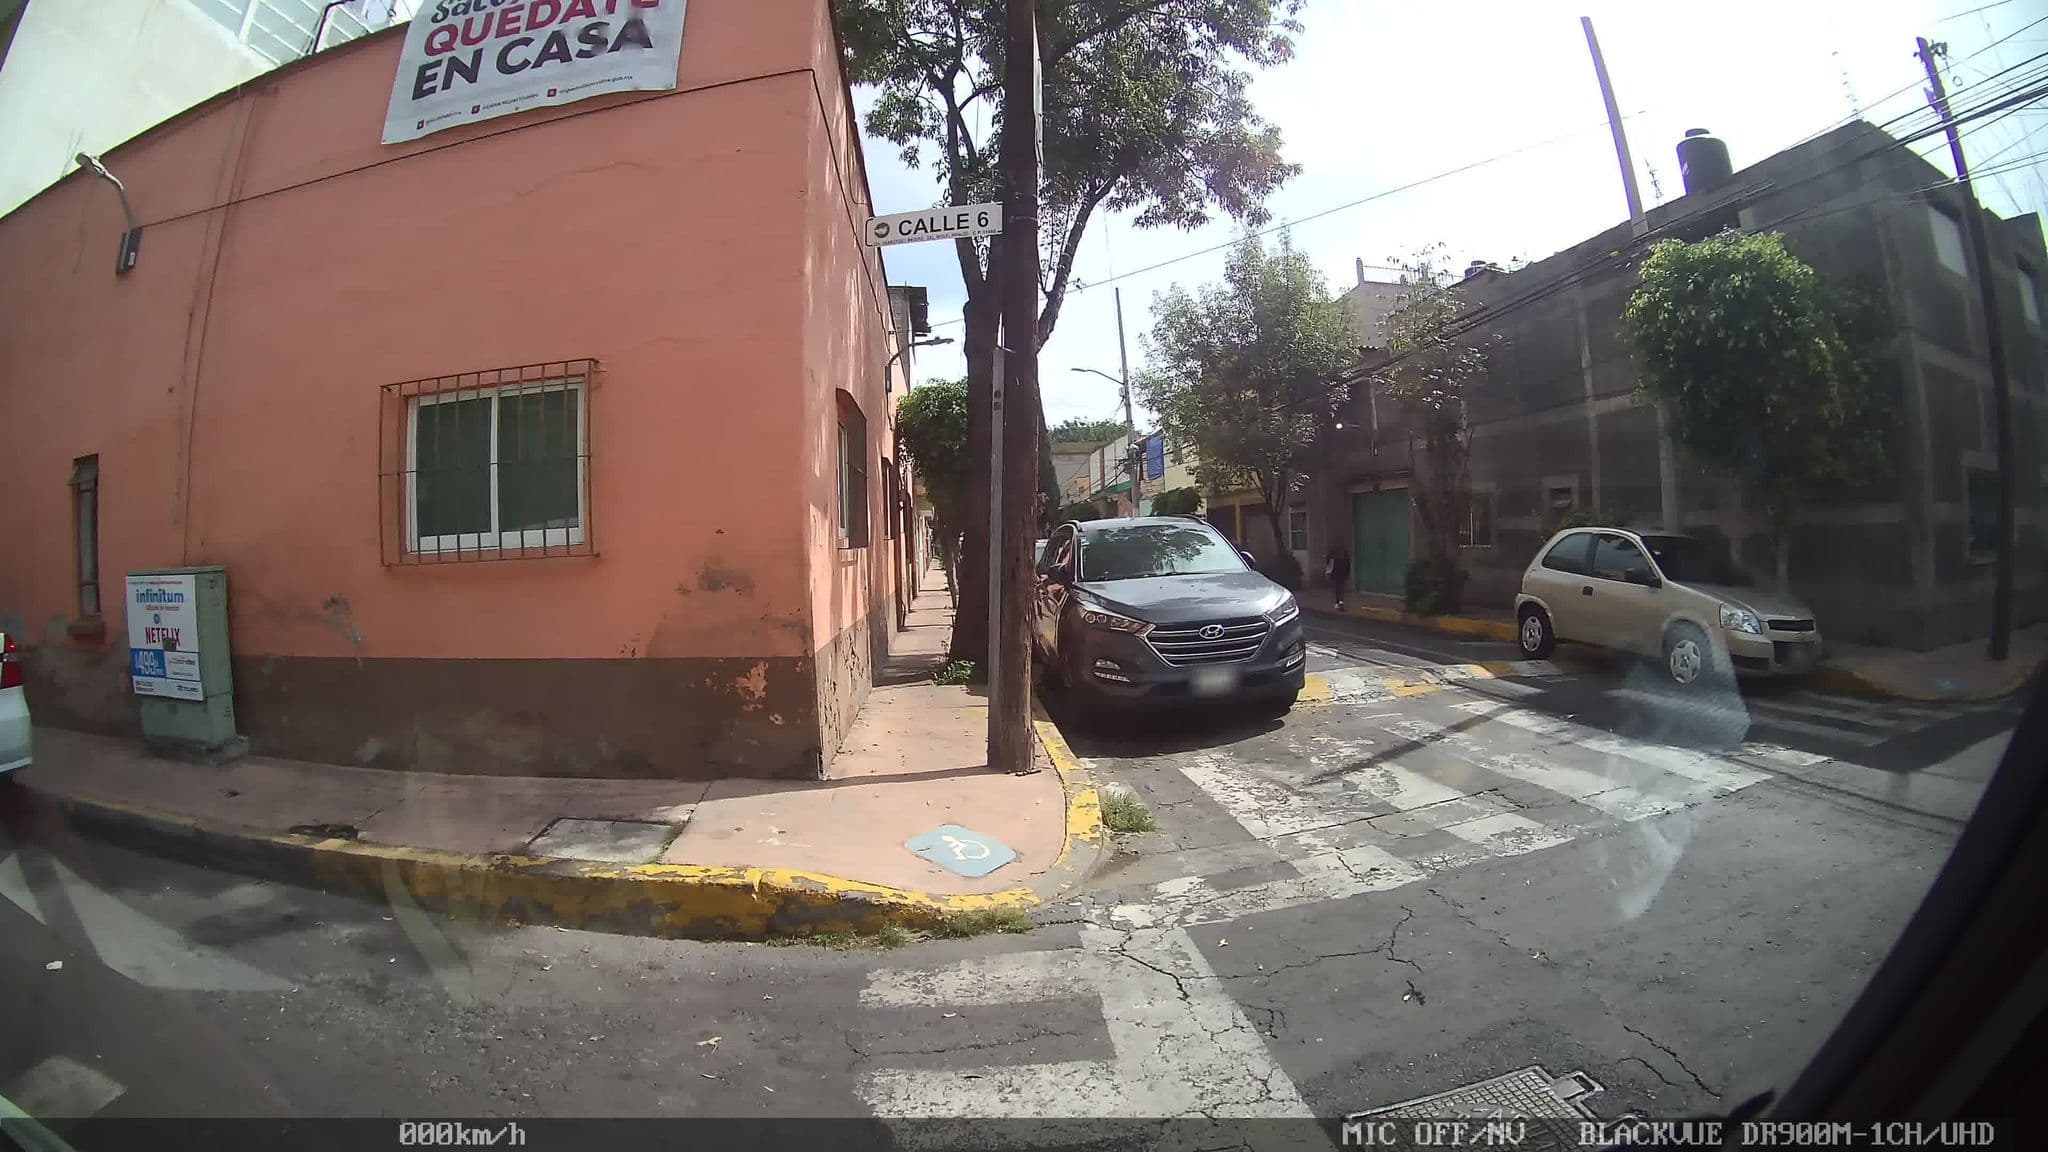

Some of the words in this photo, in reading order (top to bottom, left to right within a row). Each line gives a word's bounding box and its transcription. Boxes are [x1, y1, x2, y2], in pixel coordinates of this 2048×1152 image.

[411, 48, 483, 101] EN
[496, 18, 654, 75] CASA
[898, 213, 970, 236] CALLE
[977, 211, 989, 228] 6
[136, 588, 184, 604] infinitum
